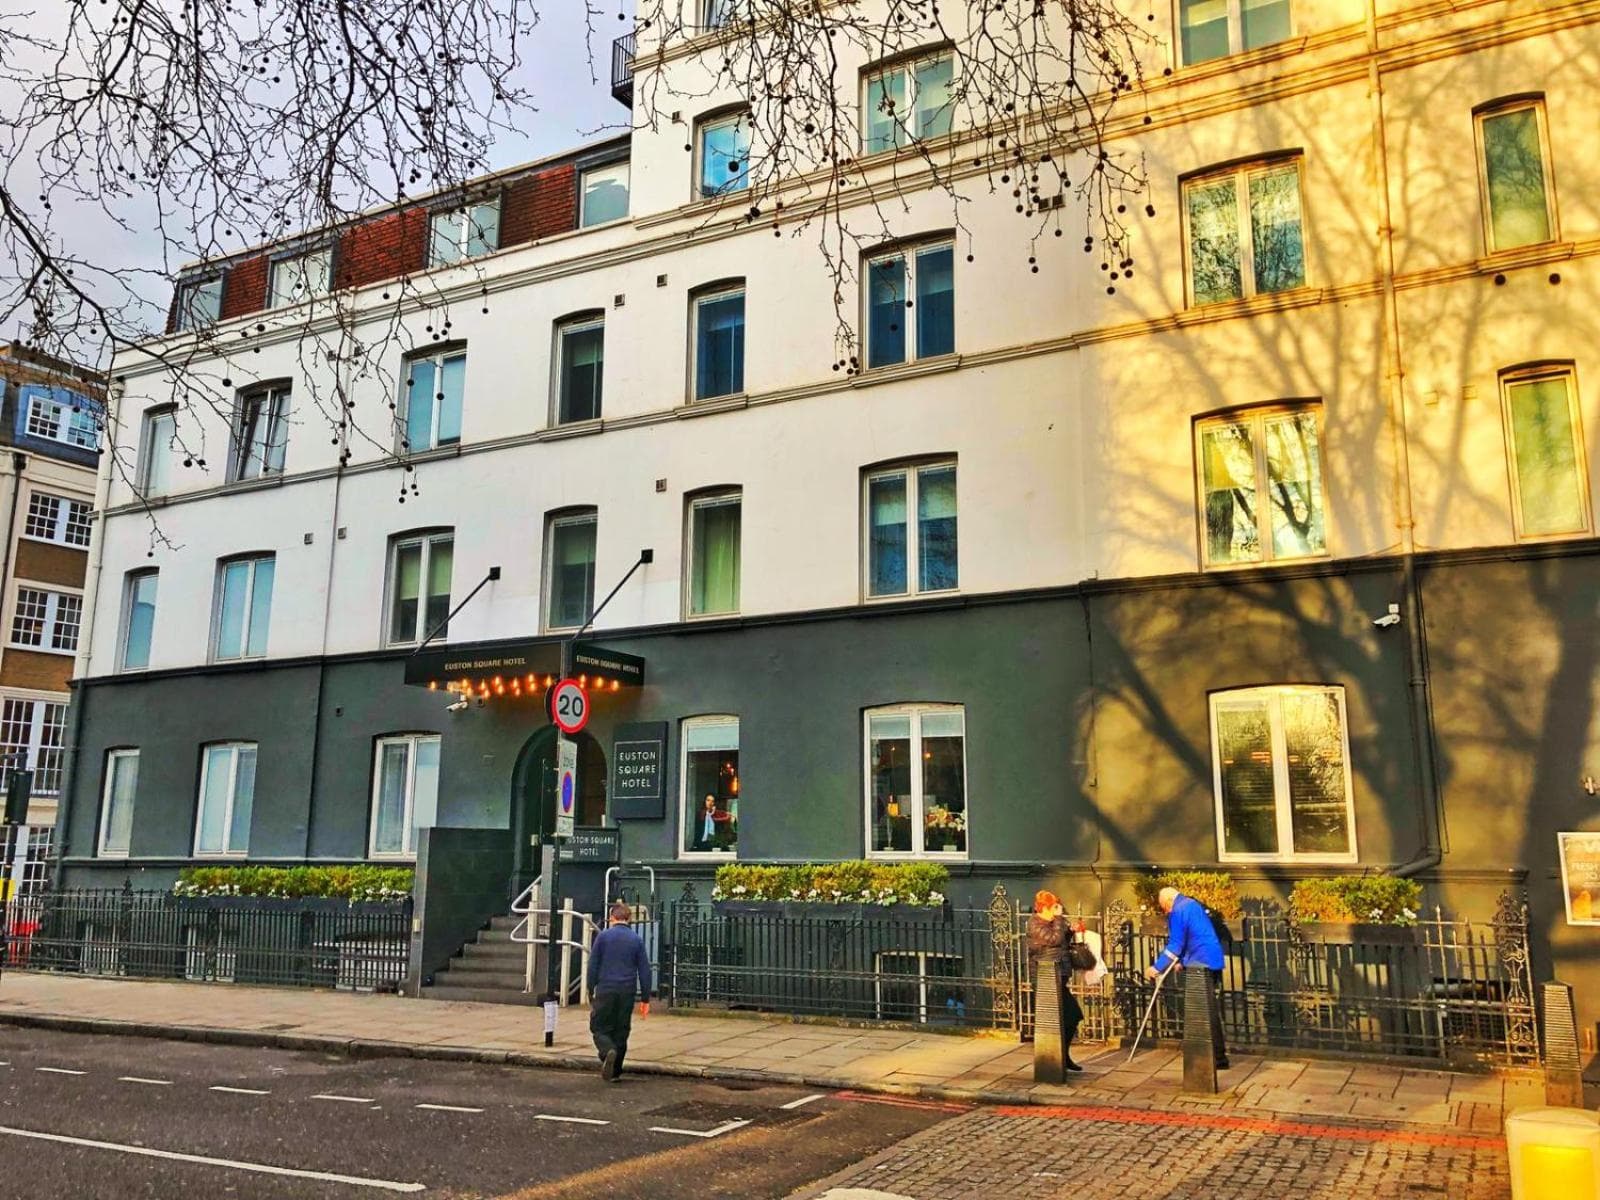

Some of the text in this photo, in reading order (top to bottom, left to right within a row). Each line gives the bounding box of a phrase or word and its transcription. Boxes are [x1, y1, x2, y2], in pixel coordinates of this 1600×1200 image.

[445, 657, 526, 671] EUSTON SQUARE HOTEL
[559, 694, 584, 717] 20
[619, 751, 656, 761] EUSTON
[618, 764, 656, 775] SQUARE
[621, 778, 651, 788] HOTEL
[591, 836, 615, 845] SQUARE
[579, 847, 600, 857] HOTEL
